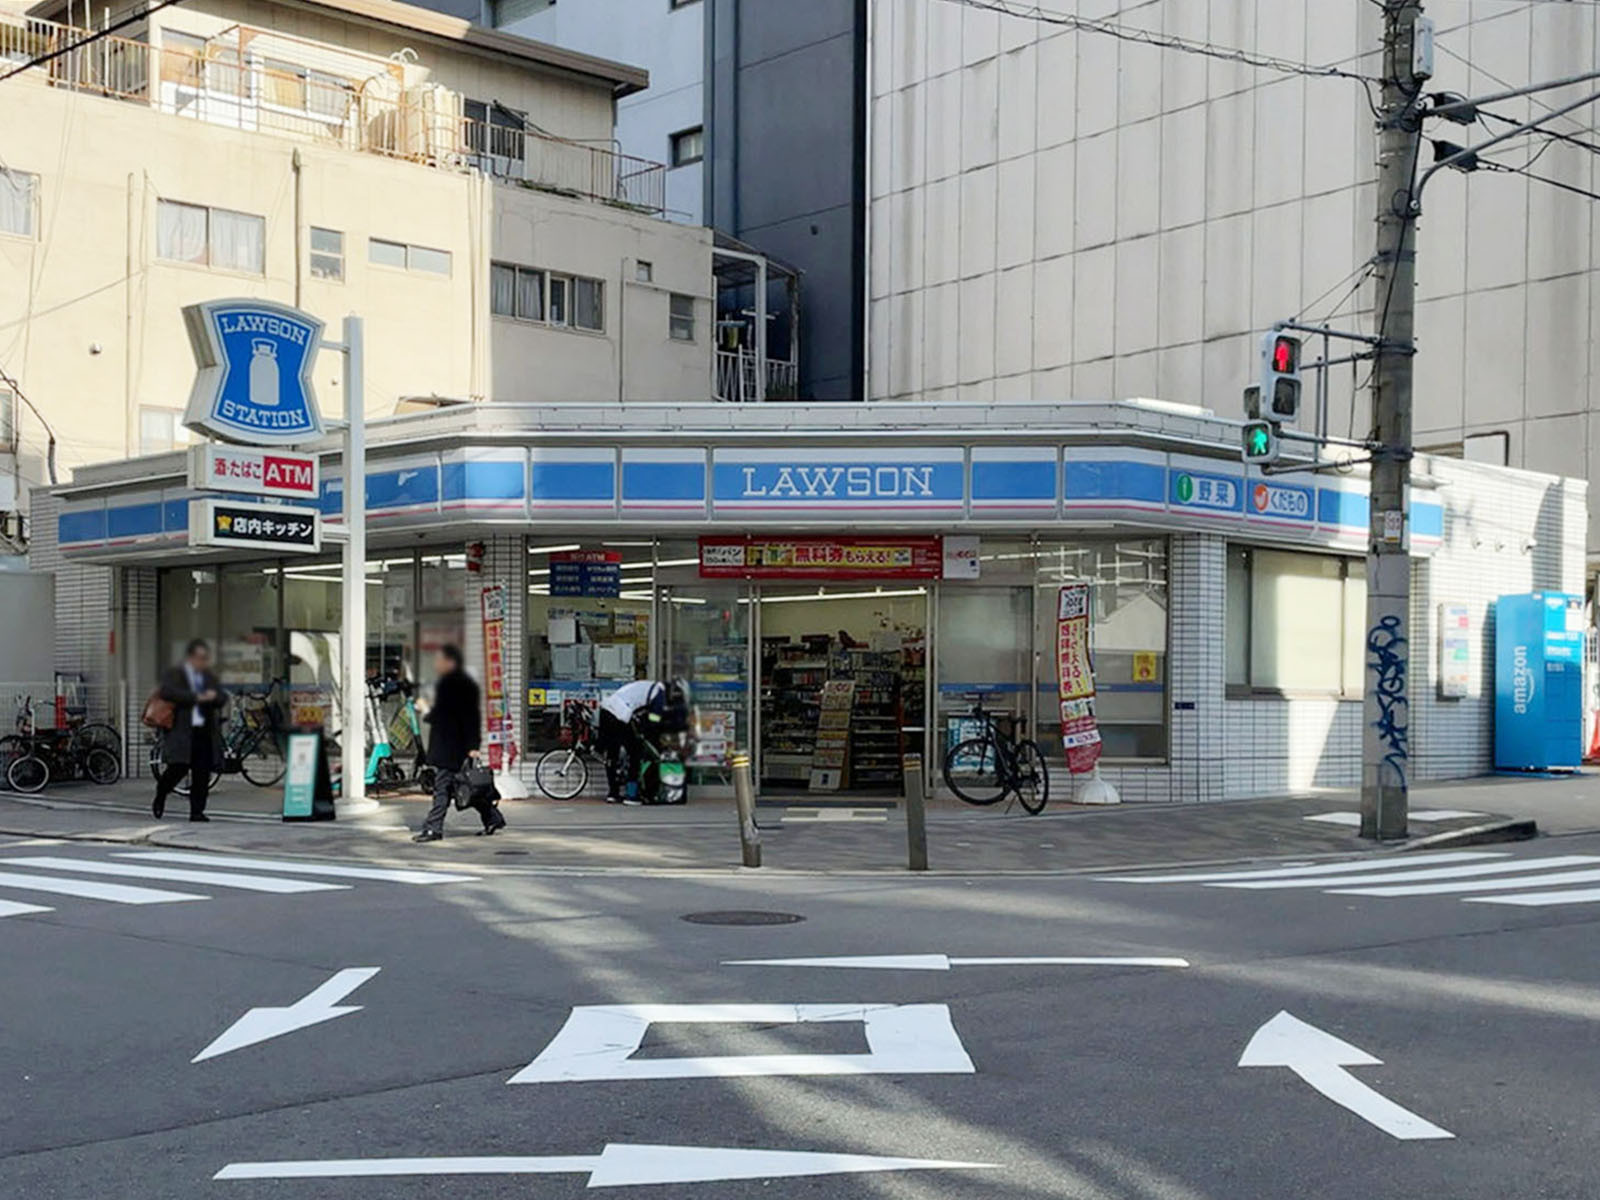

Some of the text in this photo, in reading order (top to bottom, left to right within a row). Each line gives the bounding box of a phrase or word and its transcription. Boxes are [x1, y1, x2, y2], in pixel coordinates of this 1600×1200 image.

[222, 315, 307, 345] LAWSON
[222, 400, 305, 428] STATION
[265, 463, 312, 485] ATM
[742, 467, 933, 496] LAWSON
[1270, 490, 1305, 513] くだもの
[233, 517, 313, 537] 店内キッチン
[1513, 645, 1528, 715] amazon
